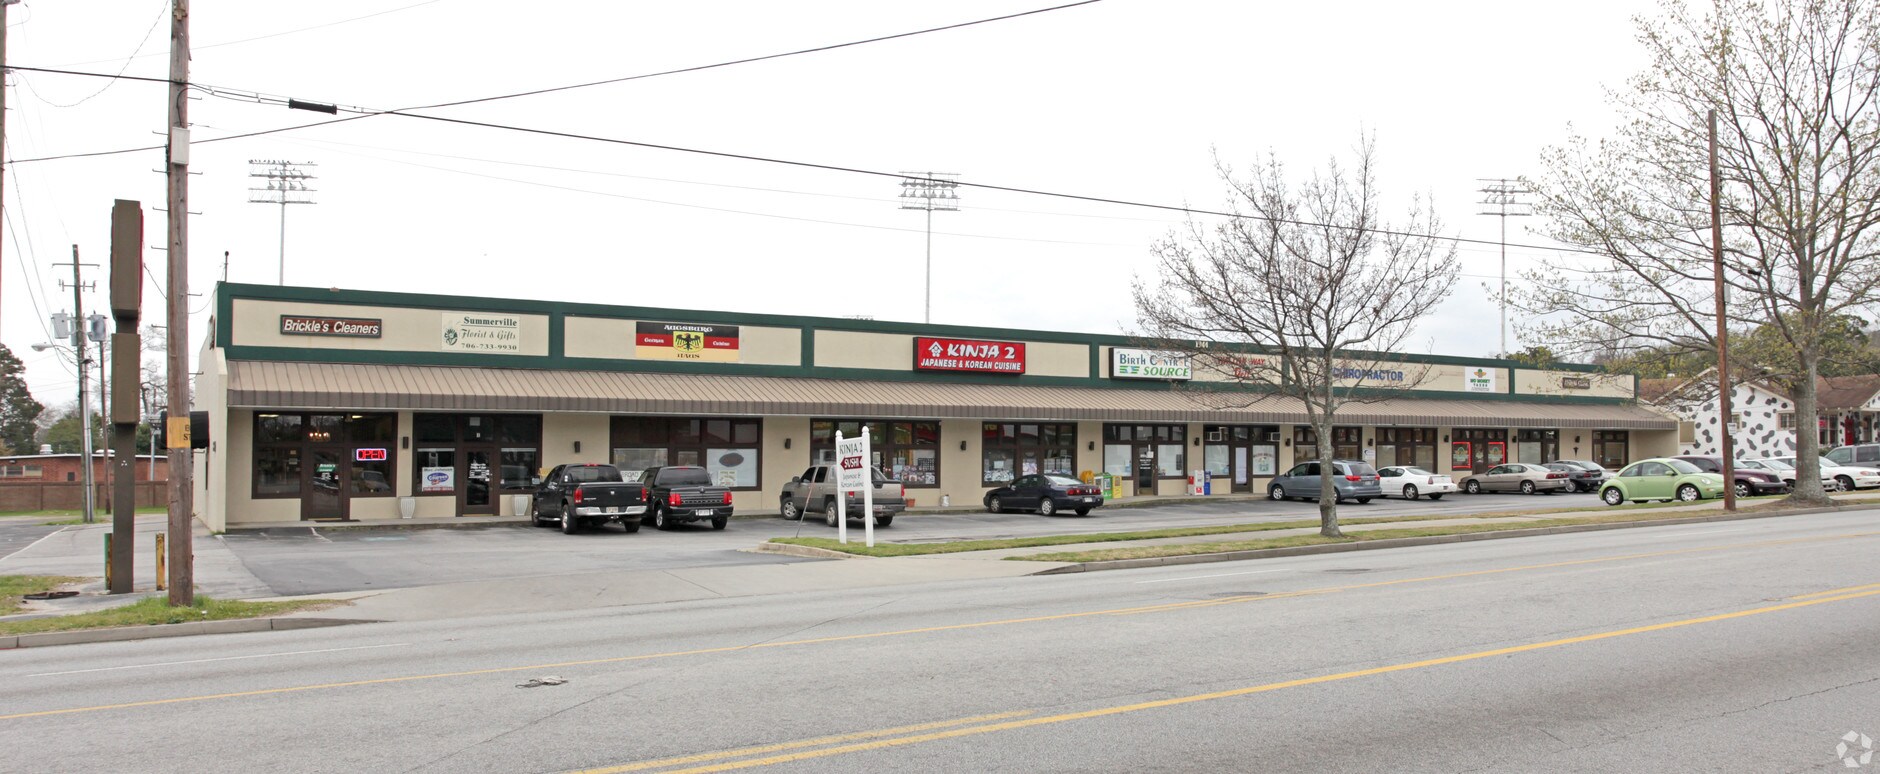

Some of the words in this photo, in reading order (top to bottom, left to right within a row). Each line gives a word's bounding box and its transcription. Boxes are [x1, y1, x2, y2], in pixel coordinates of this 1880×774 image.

[284, 319, 330, 332] Brickle's
[333, 321, 379, 334] Cleaners
[463, 316, 517, 327] Summerville
[461, 328, 487, 339] Florist
[496, 330, 516, 341] Gifts
[663, 324, 713, 333] AUGSBURG
[947, 343, 1000, 359] KINJA
[1004, 346, 1016, 359] 2
[920, 358, 957, 368] JAPANESE
[958, 360, 963, 368] &
[965, 360, 992, 369] KOREAN
[994, 362, 1021, 370] CUISINE
[1143, 366, 1189, 377] SOURCE
[1332, 367, 1404, 381] CHIROPRACTOR
[358, 450, 384, 460] OPEN
[839, 443, 859, 455] KINJA
[844, 457, 860, 469] SUSHI
